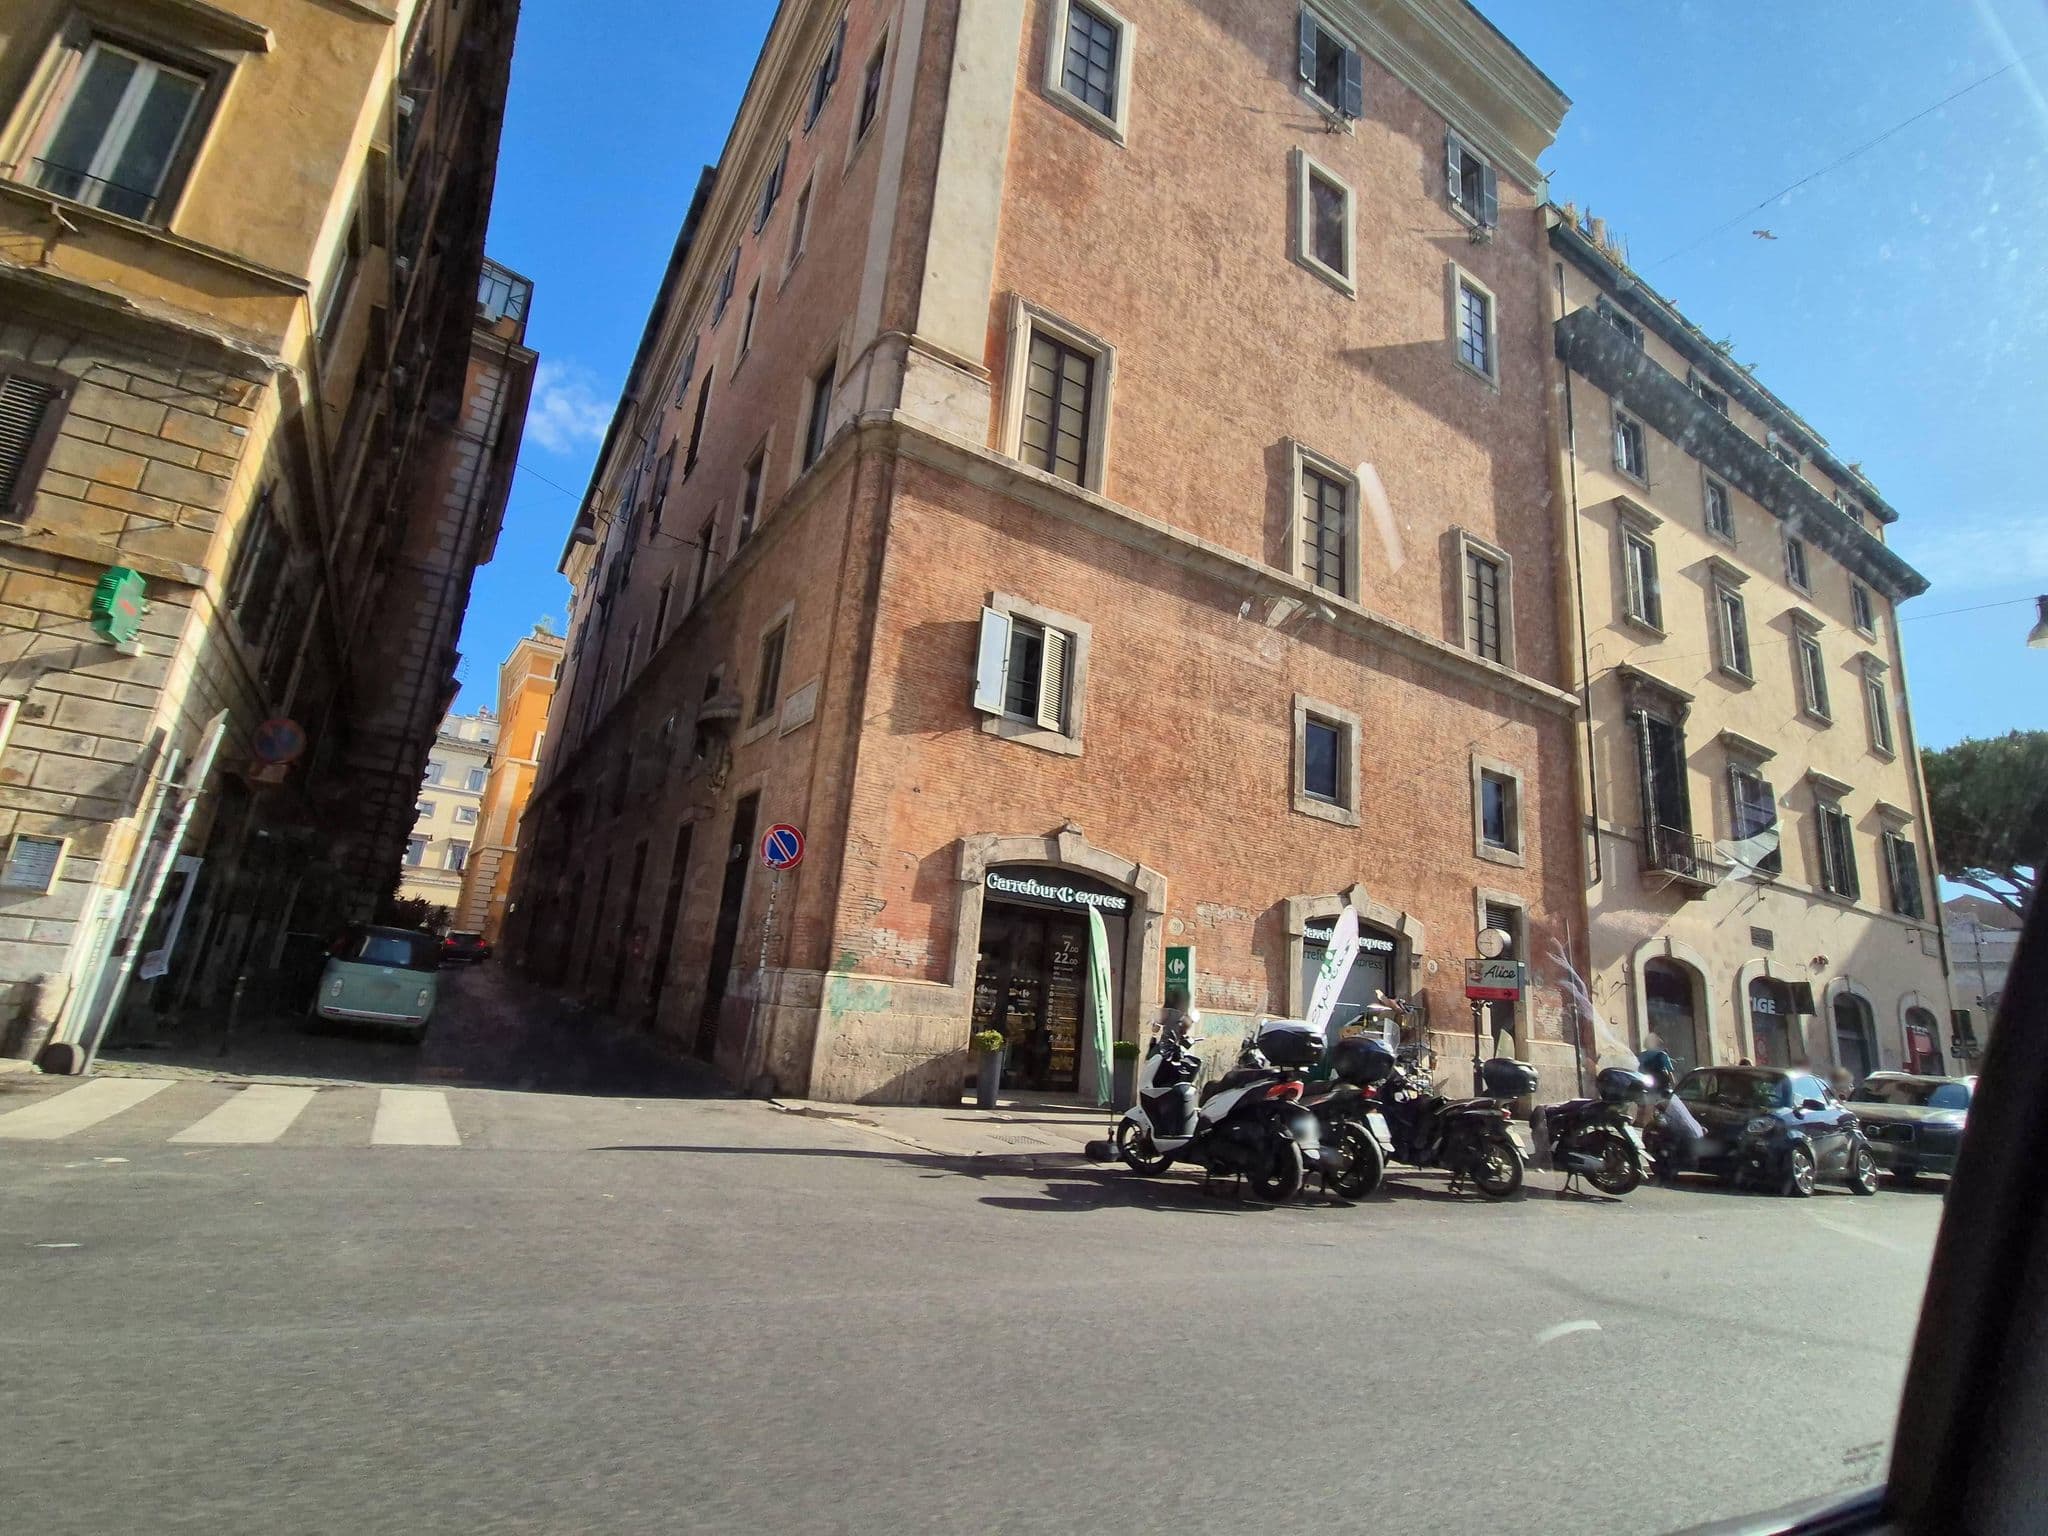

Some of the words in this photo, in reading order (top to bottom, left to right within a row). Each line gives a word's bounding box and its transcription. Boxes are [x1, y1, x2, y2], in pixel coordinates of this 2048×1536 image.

[987, 872, 1057, 899] Carrefour
[1075, 890, 1126, 910] express
[1484, 965, 1516, 979] Alice
